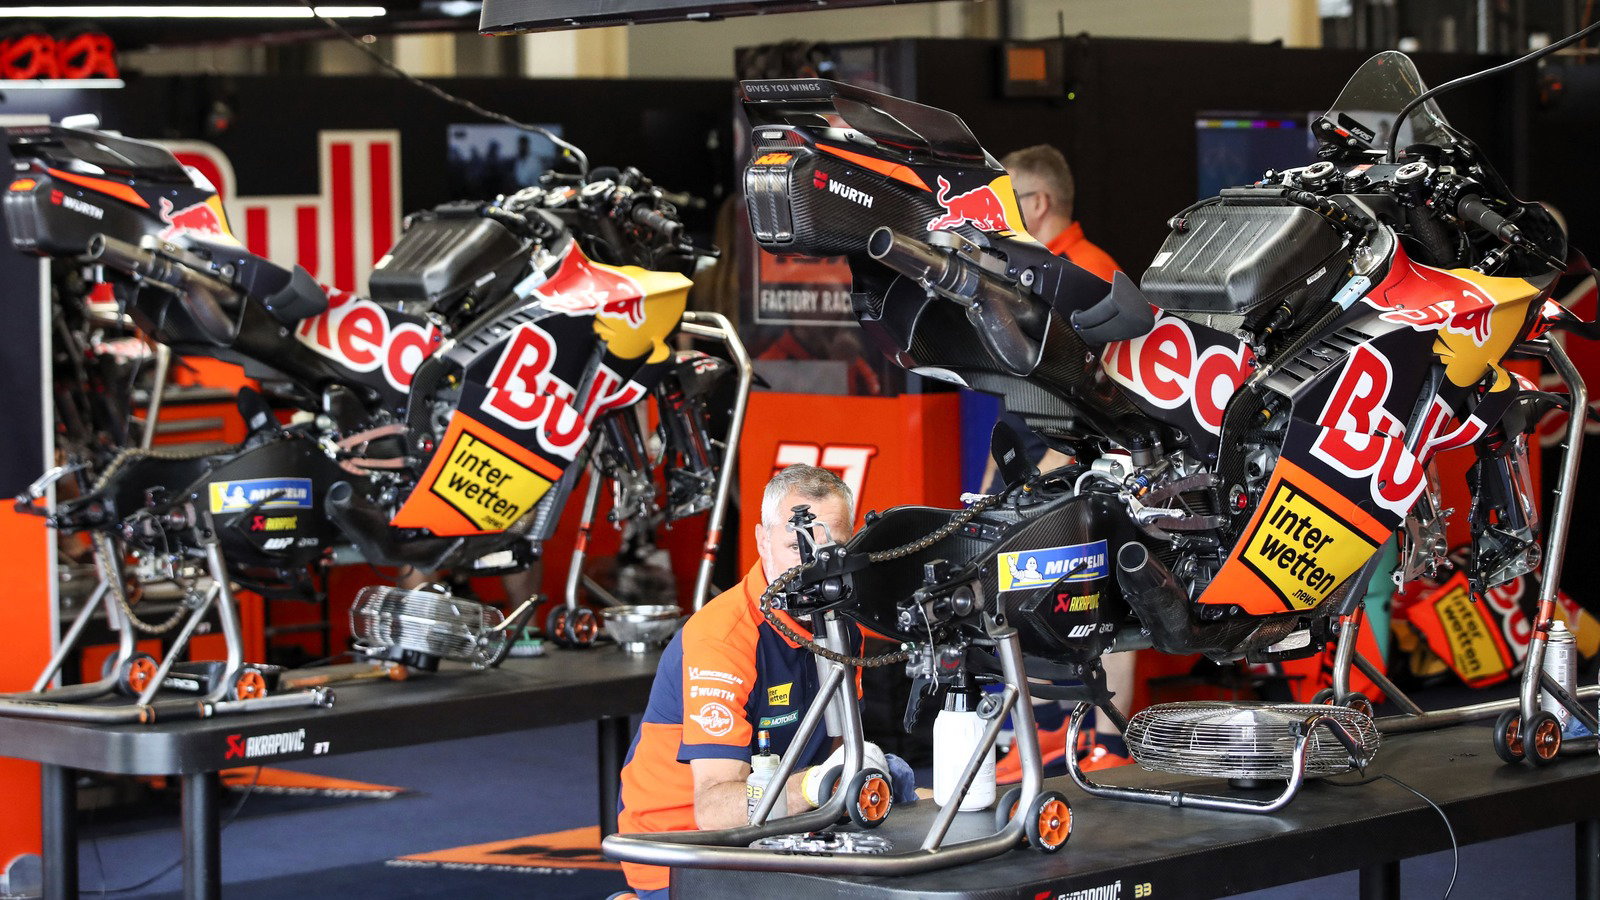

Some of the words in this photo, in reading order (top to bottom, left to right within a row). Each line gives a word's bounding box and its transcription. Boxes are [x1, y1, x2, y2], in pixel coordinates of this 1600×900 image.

[745, 84, 770, 92] GIVES
[771, 84, 789, 92] YOU
[790, 83, 820, 91] WINGS
[761, 290, 818, 312] FACTORY
[454, 438, 513, 488] inter
[447, 472, 520, 520] wetten
[1269, 491, 1334, 554] inter
[1258, 533, 1336, 594] wetten
[1291, 588, 1317, 606] .news
[1134, 882, 1152, 899] 33
